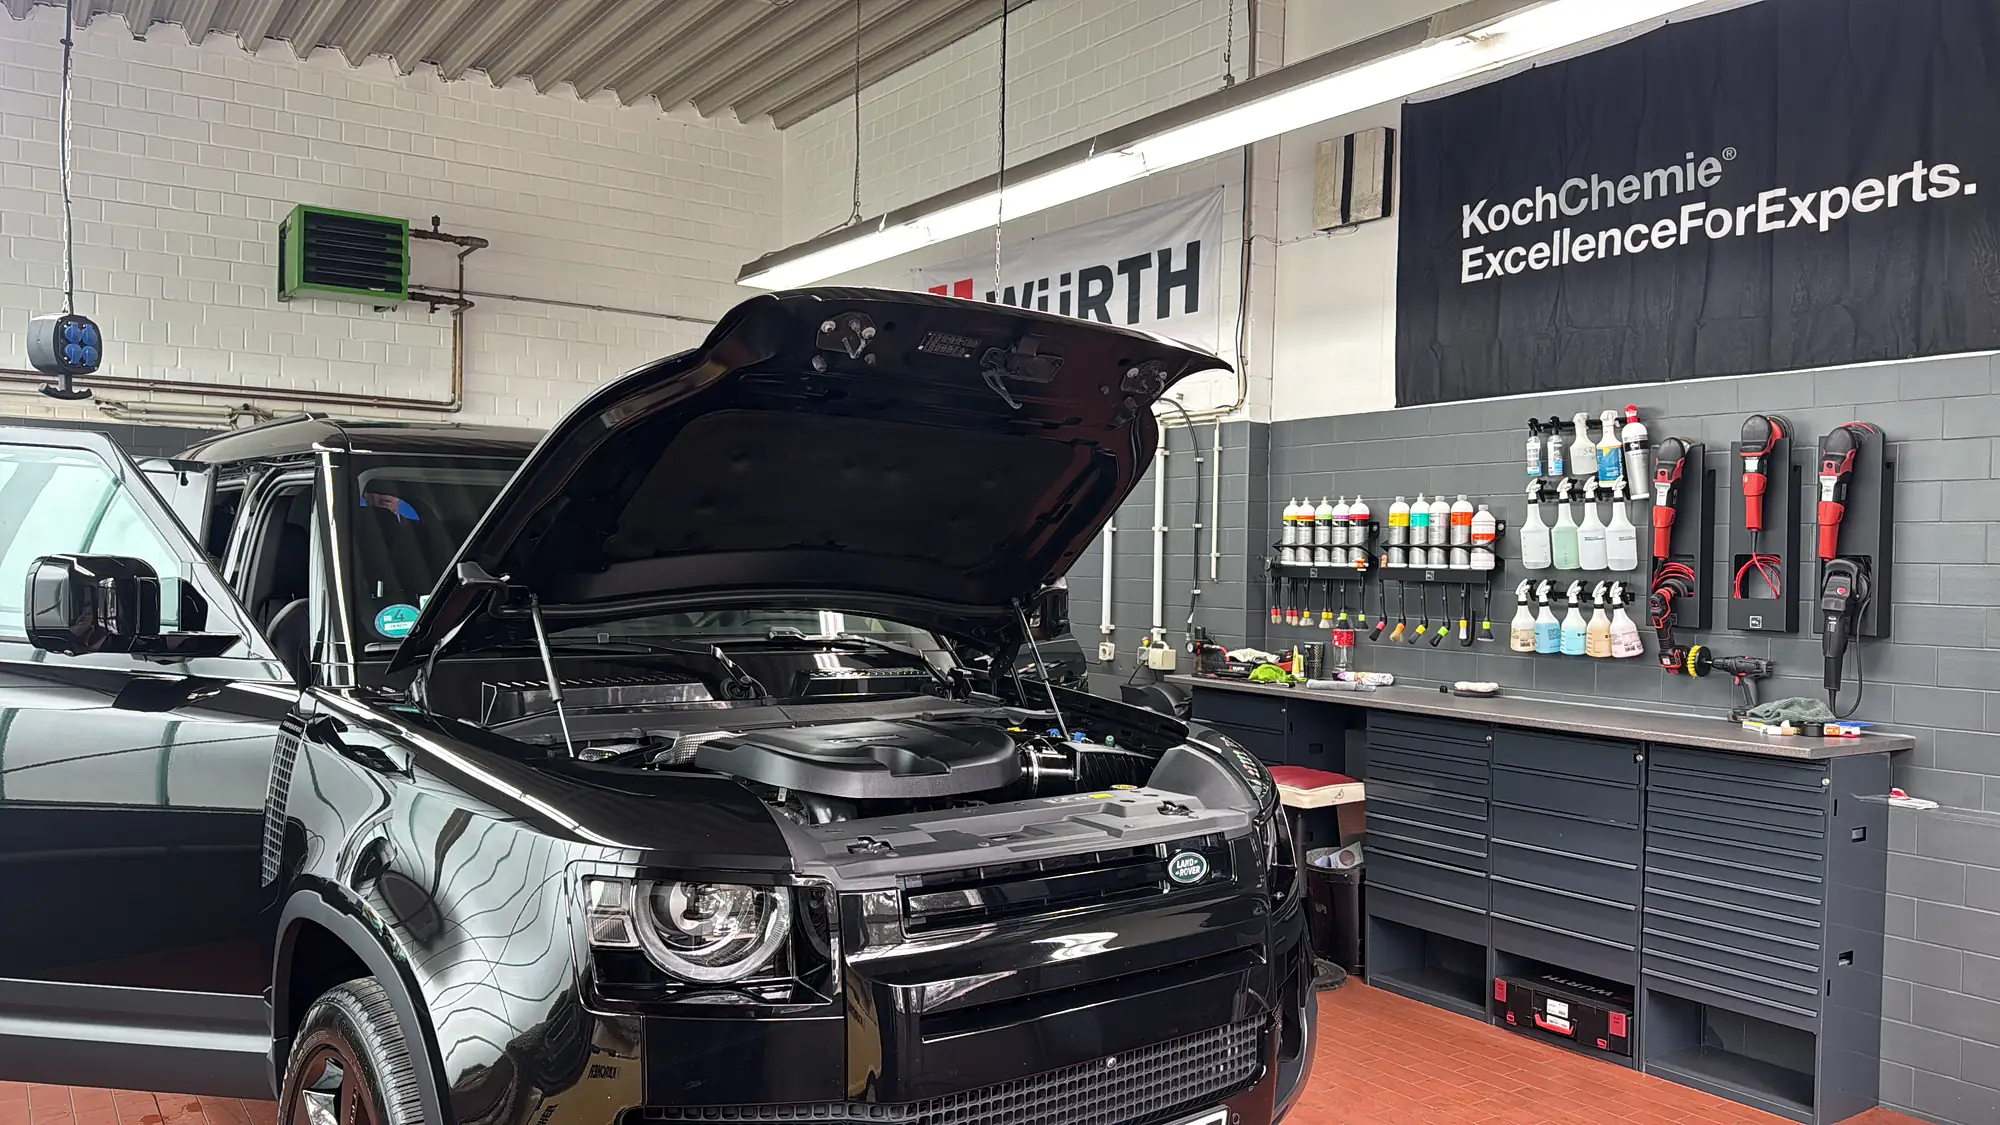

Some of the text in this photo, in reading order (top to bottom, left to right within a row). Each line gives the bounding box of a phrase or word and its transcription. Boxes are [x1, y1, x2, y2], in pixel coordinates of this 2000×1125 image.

[1460, 159, 1977, 284] ExcellenceForExperts.
[1177, 858, 1194, 869] LAND
[1180, 866, 1201, 877] ROVER
